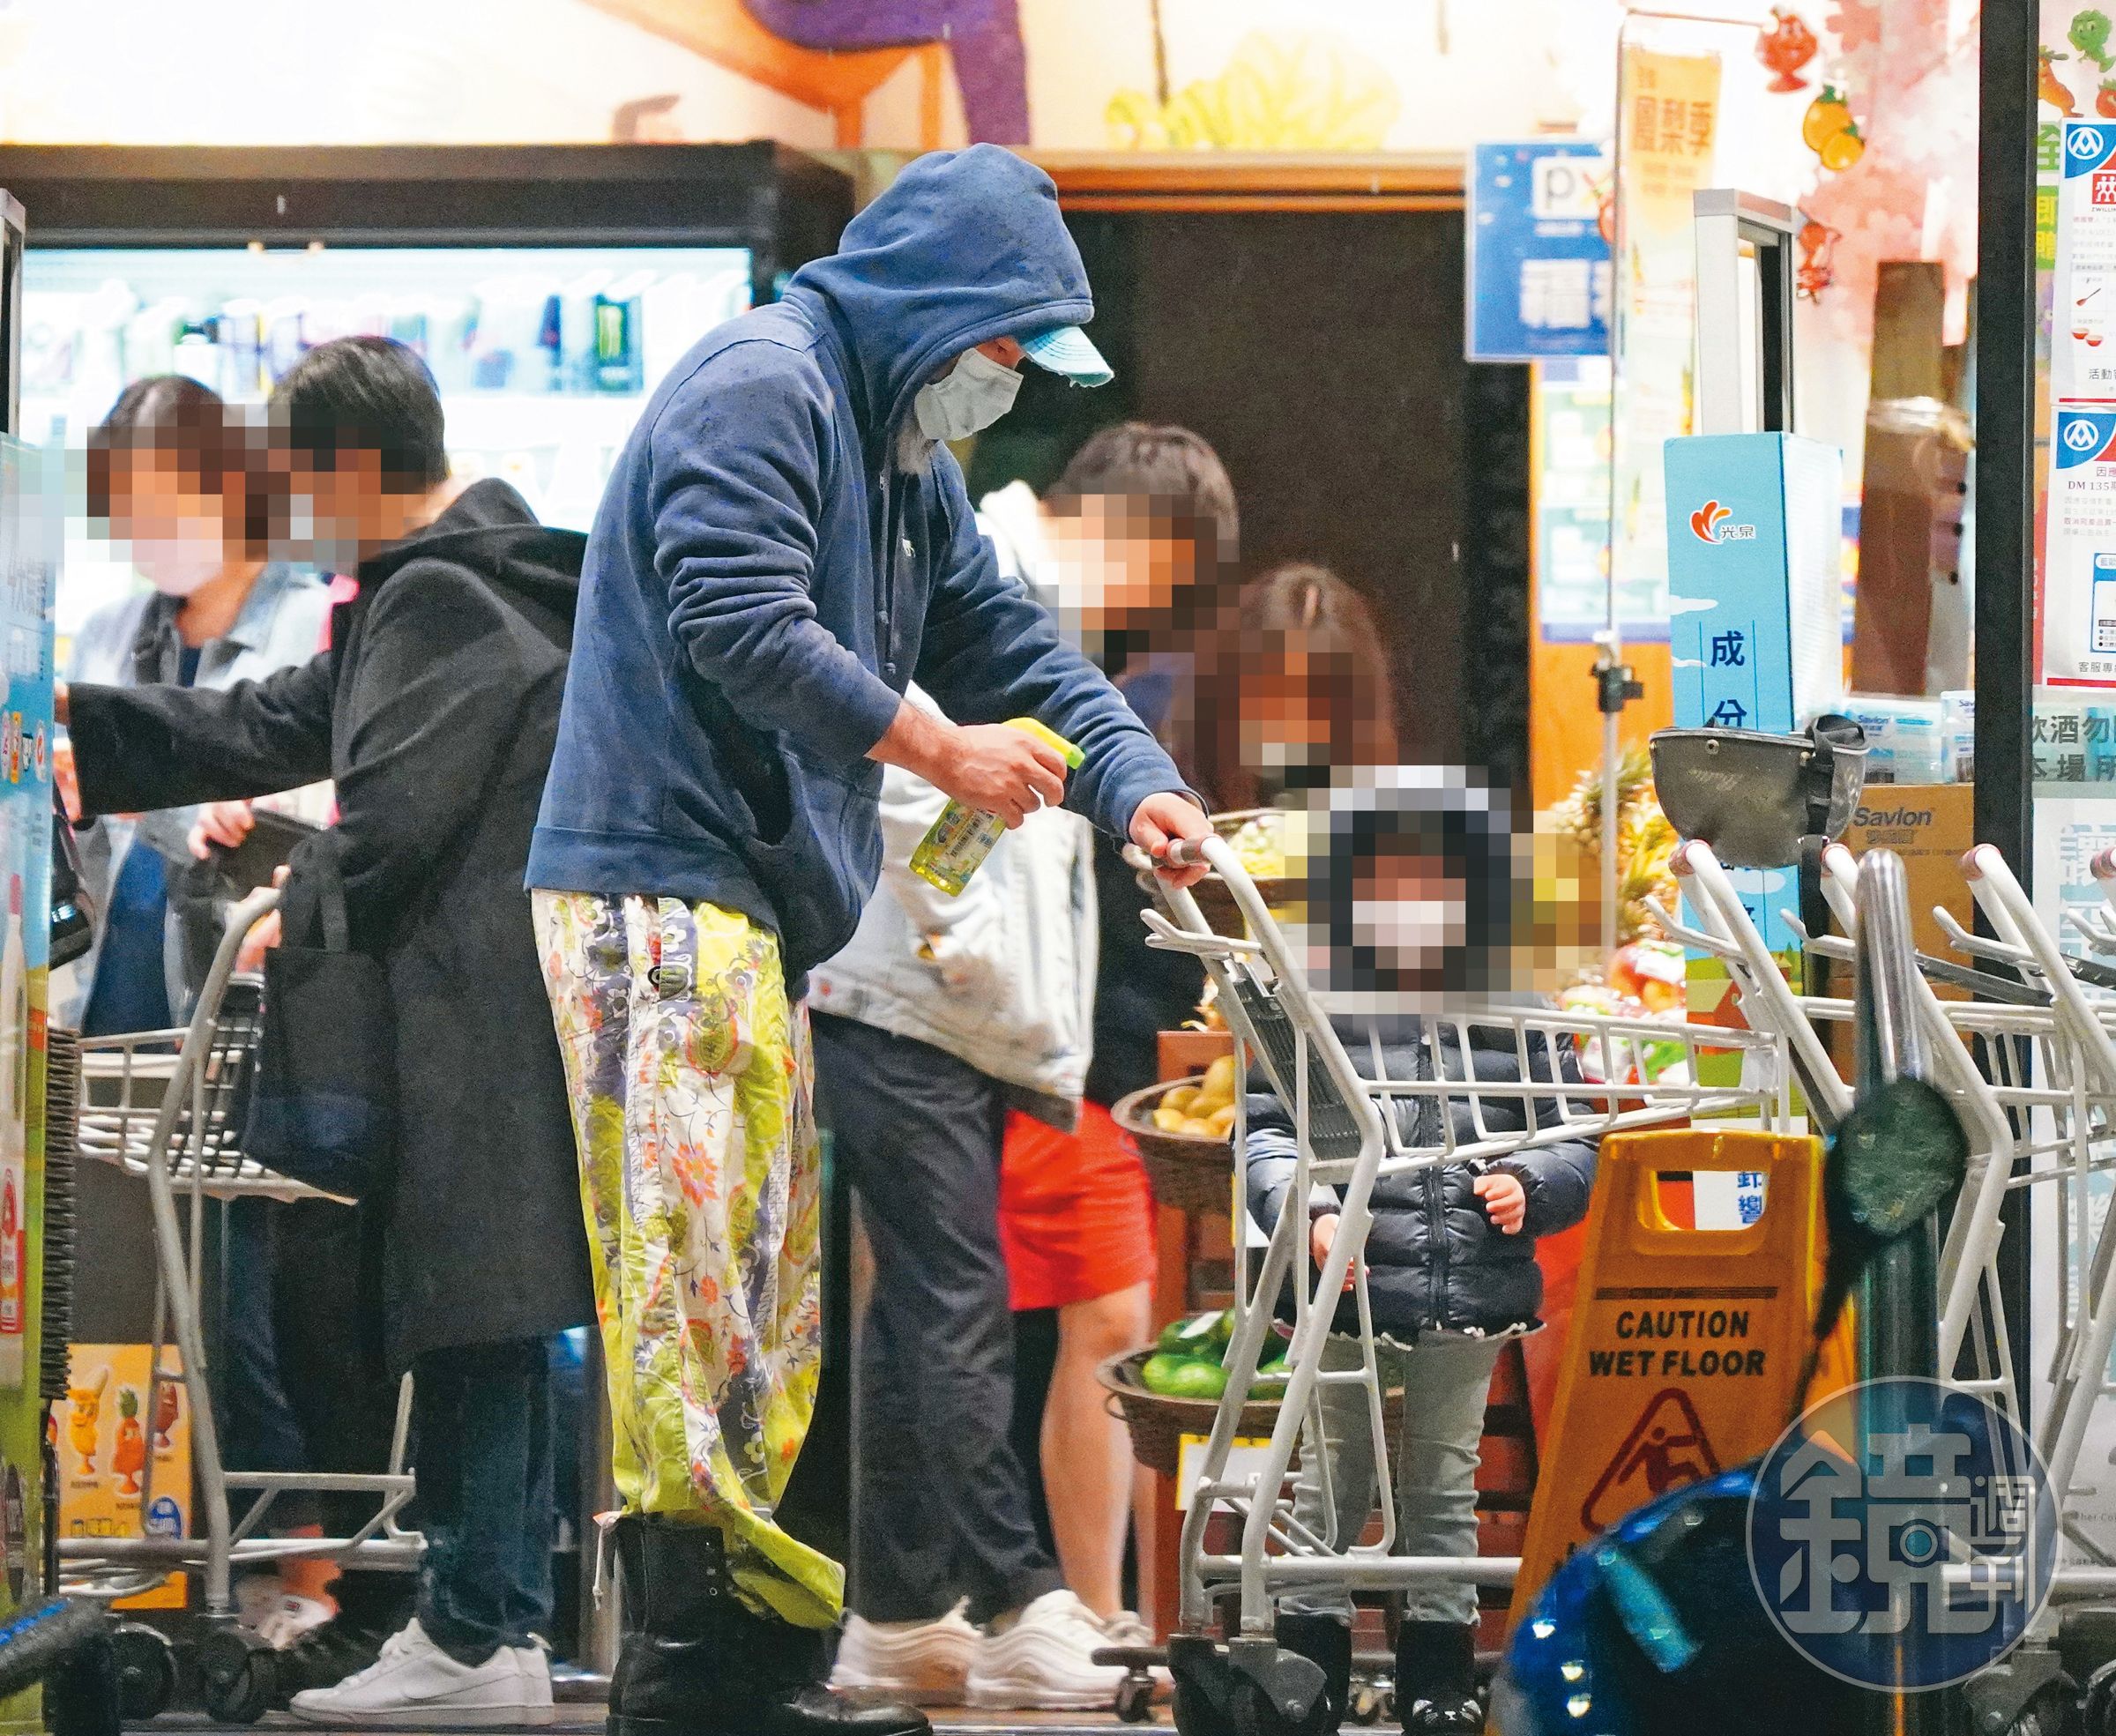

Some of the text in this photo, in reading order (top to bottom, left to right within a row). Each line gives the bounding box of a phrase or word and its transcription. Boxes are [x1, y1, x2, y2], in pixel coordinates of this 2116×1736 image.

[2068, 481, 2086, 490] DM
[1720, 525, 1755, 539] 光泉
[1852, 806, 1932, 827] Savlon
[1615, 1310, 1749, 1339] CAUTION
[1589, 1349, 1766, 1377] WET FLOOR
